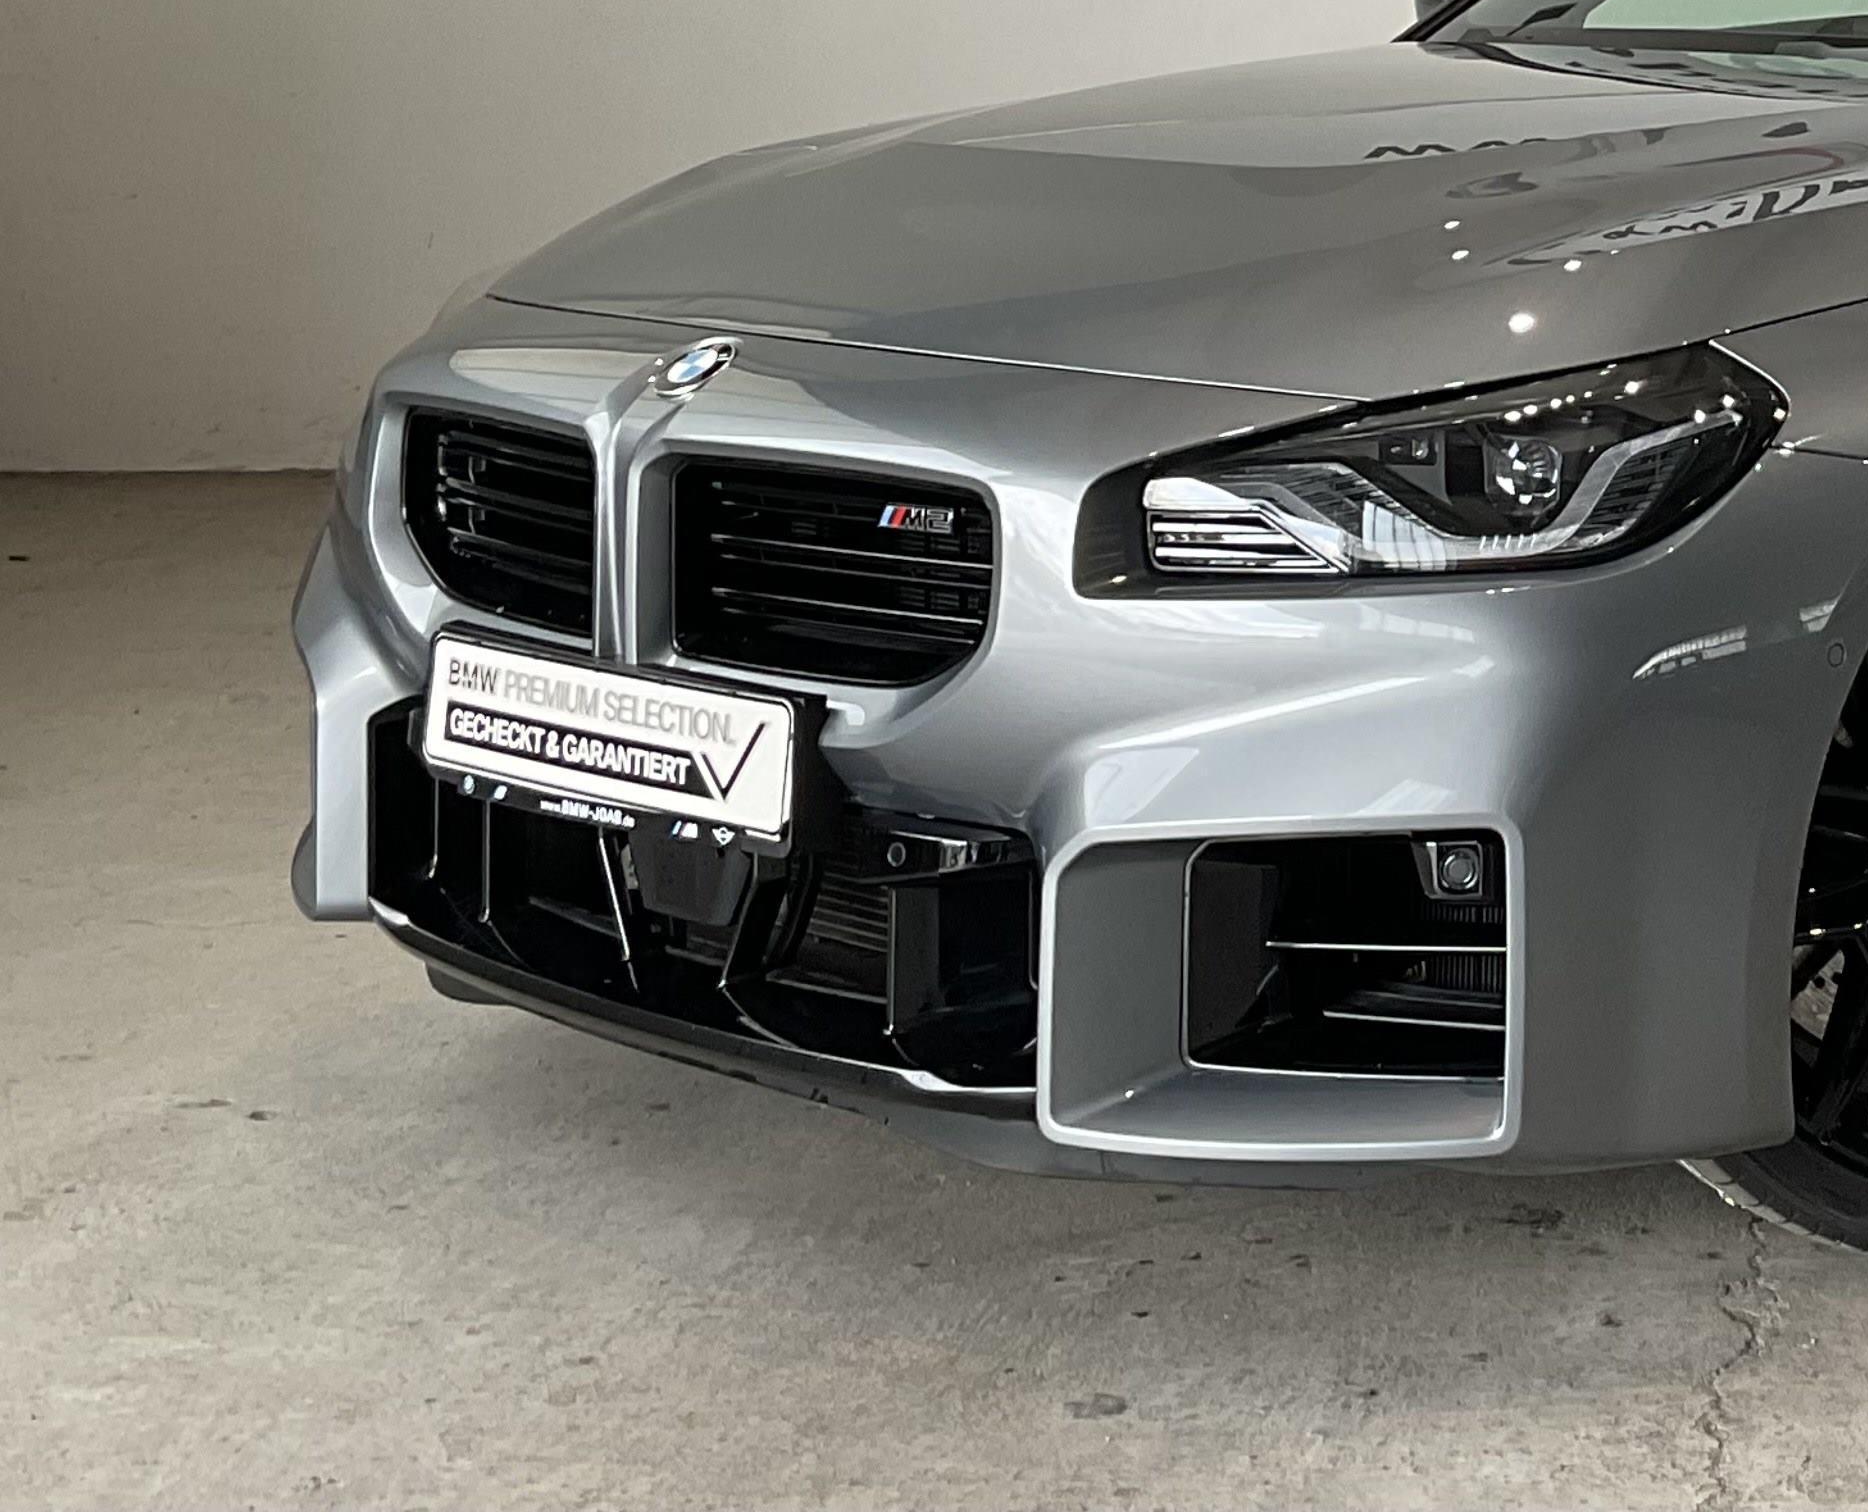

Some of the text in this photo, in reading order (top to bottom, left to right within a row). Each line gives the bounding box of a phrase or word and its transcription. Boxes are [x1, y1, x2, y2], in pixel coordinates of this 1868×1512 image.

[448, 658, 499, 696] BMW
[504, 669, 600, 718] PREMIUM
[449, 707, 691, 785] GECHECKT & GARANTIERT
